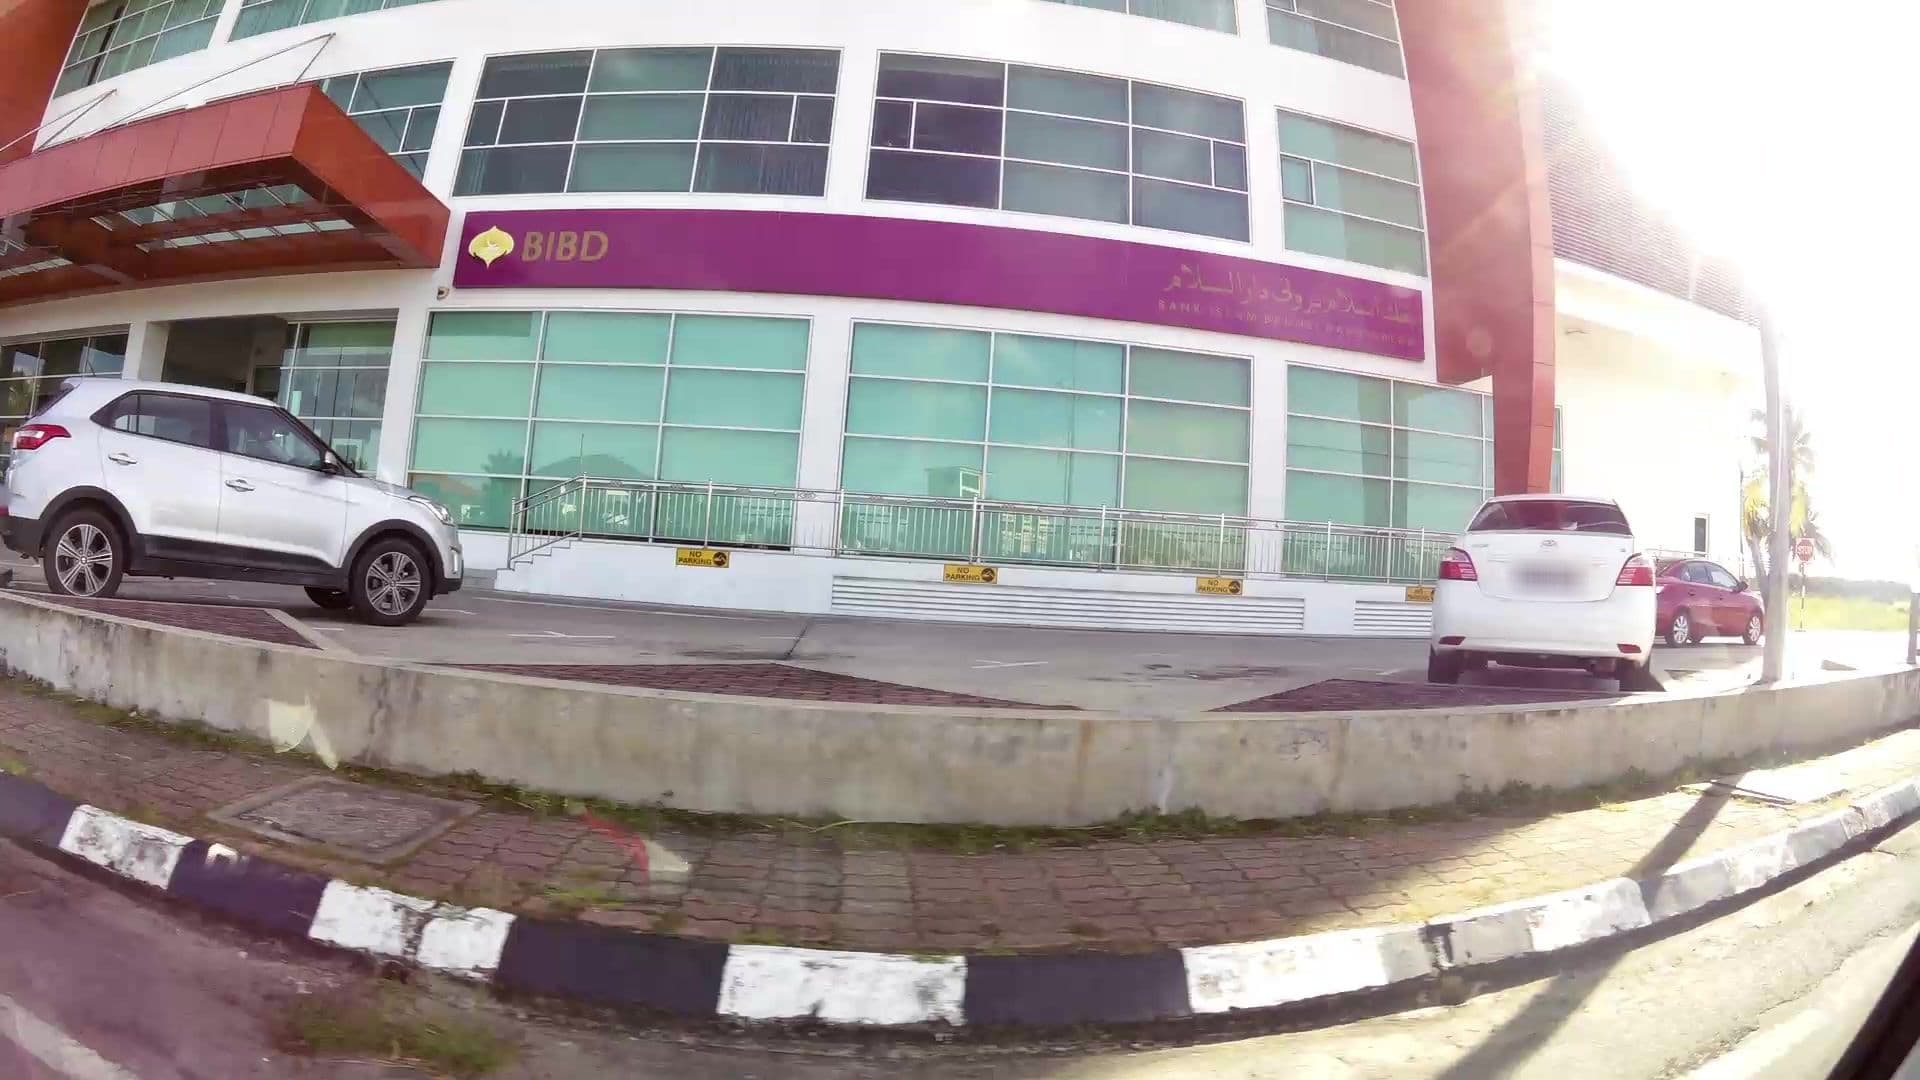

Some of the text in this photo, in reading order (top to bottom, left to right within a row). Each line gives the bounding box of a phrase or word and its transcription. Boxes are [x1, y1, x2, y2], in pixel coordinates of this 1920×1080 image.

[521, 230, 609, 263] BIBD
[1158, 298, 1201, 313] BANK
[678, 557, 712, 565] PARKING
[945, 573, 981, 581] PARKING
